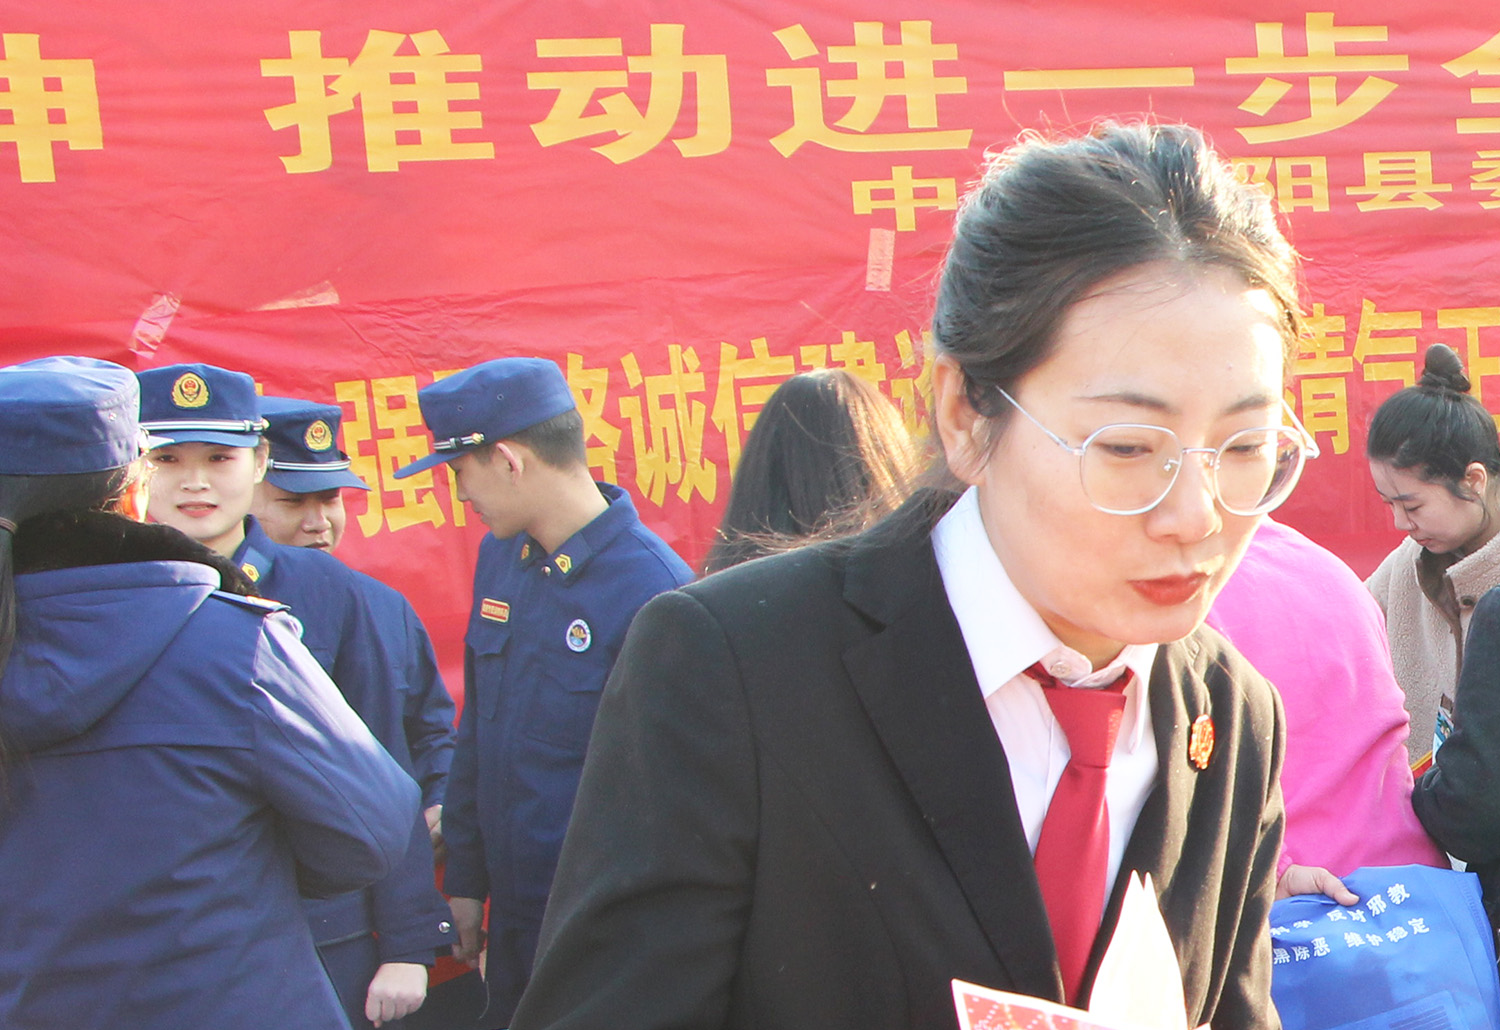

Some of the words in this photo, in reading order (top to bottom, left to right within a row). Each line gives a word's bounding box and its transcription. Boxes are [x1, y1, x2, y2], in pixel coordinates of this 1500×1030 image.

[1327, 882, 1412, 923] 反对邪教
[1343, 917, 1431, 948] 维护稳定
